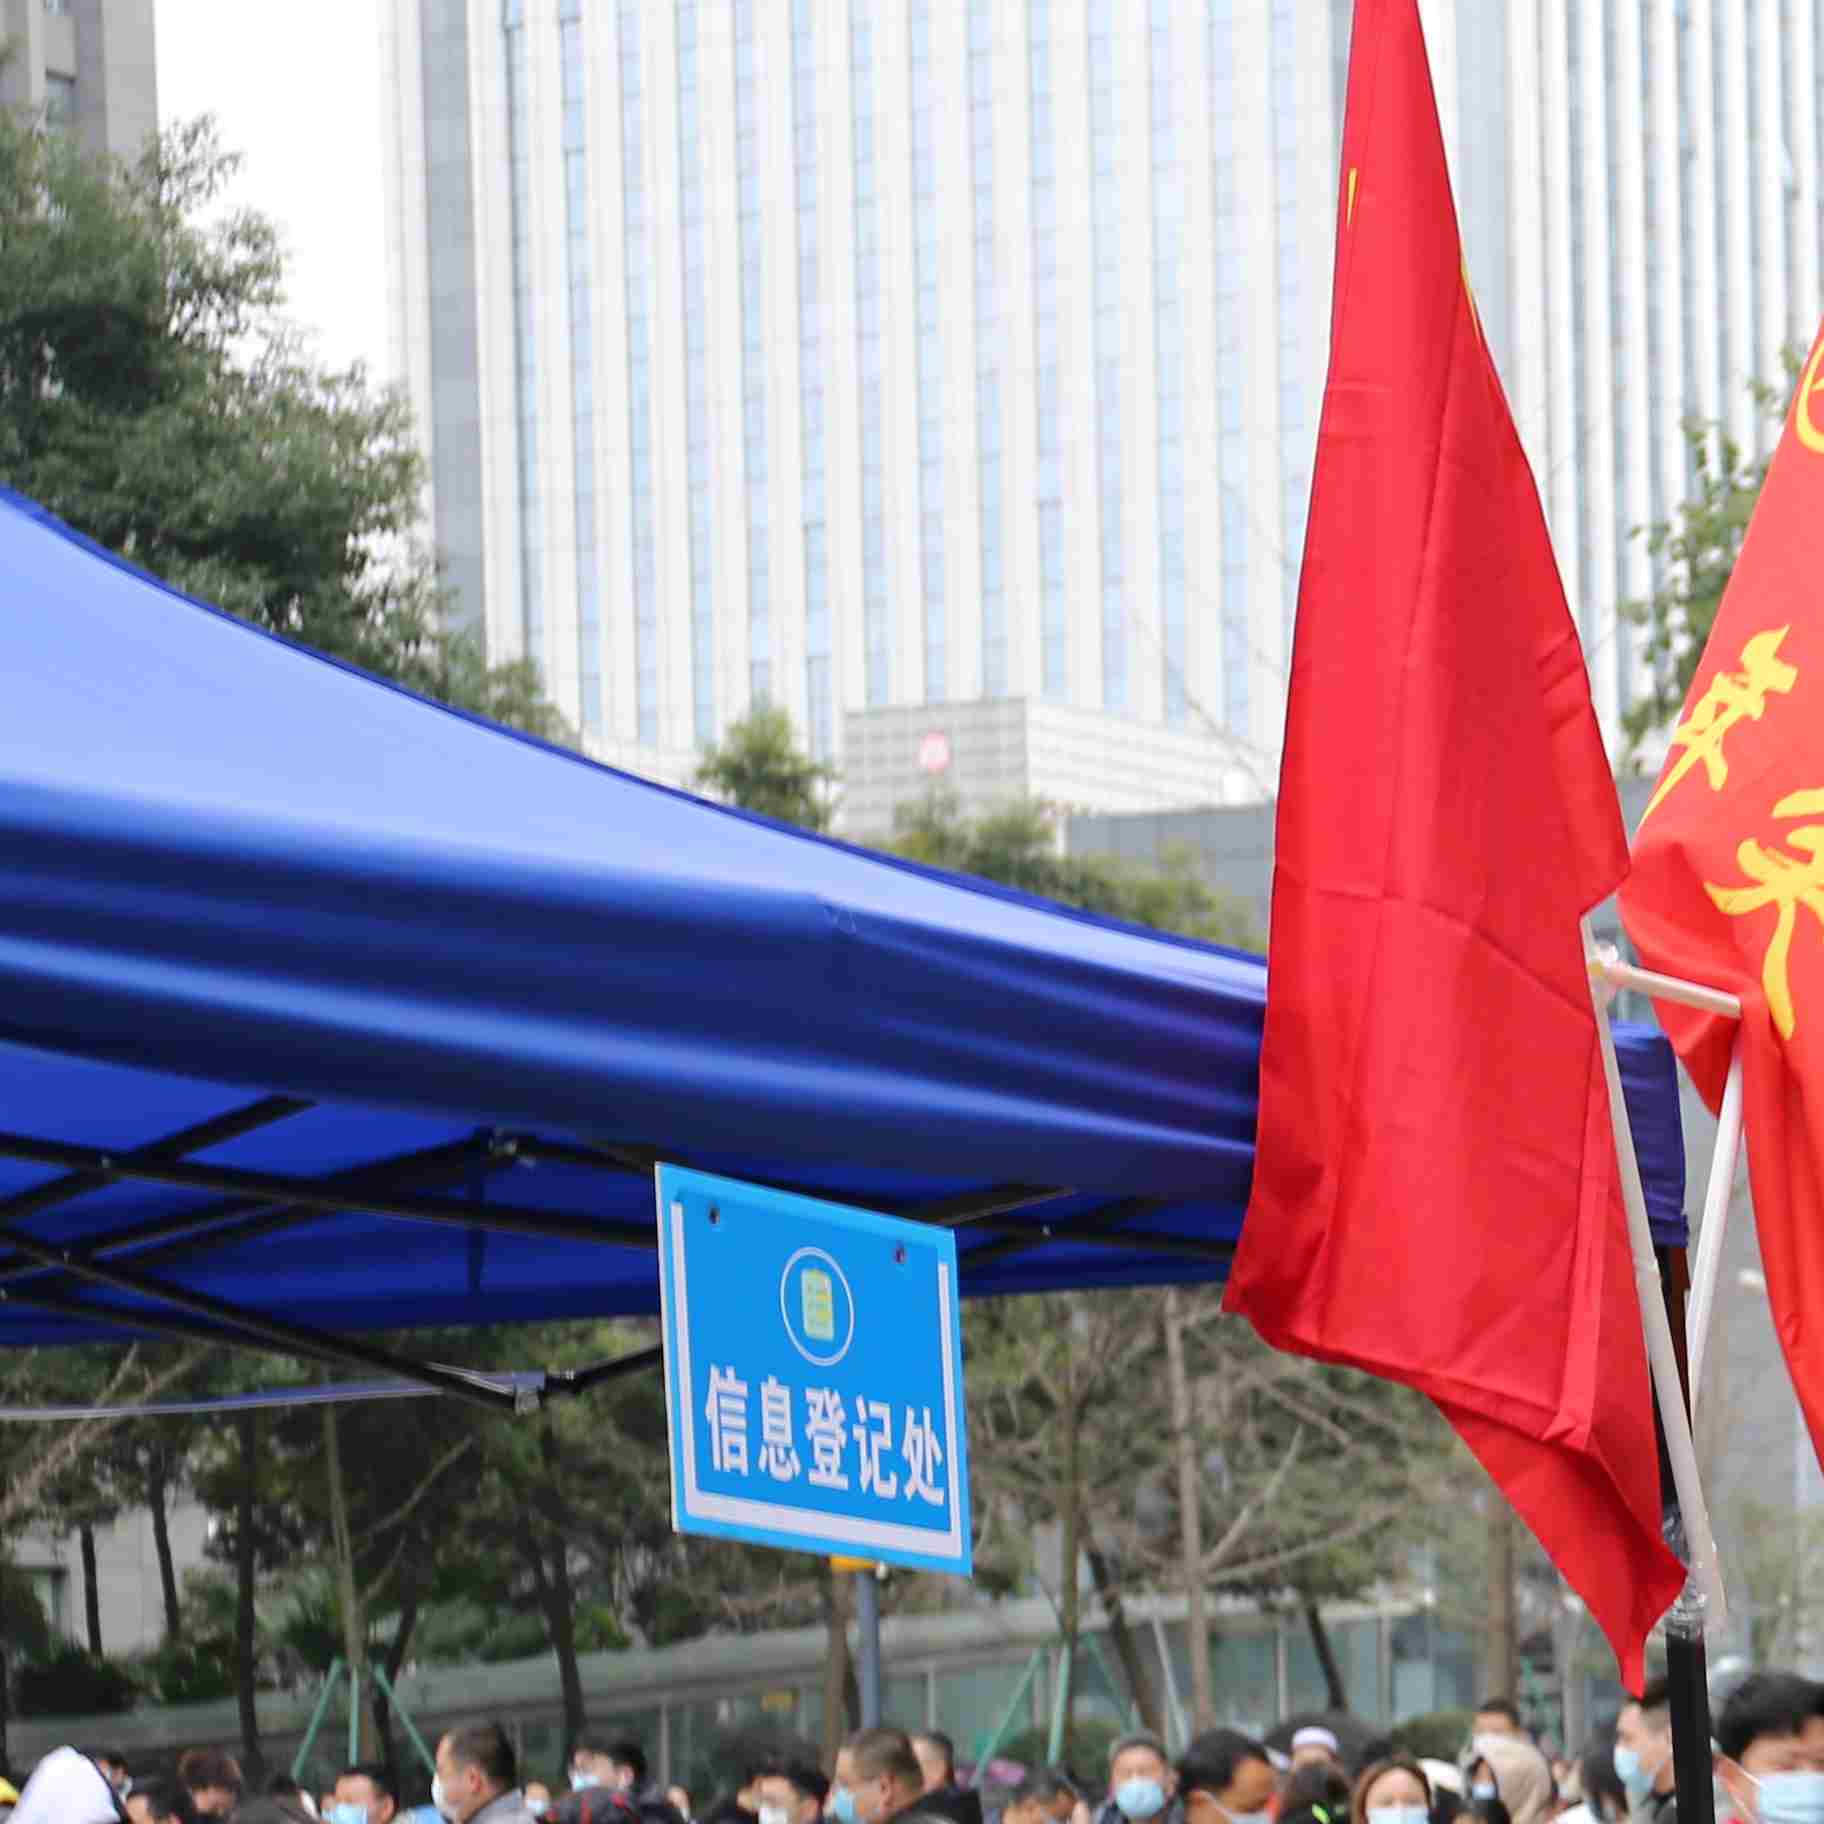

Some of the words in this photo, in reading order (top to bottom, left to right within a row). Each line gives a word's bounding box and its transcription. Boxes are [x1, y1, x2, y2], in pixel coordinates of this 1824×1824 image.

[704, 1362, 946, 1507] 信息登记处
